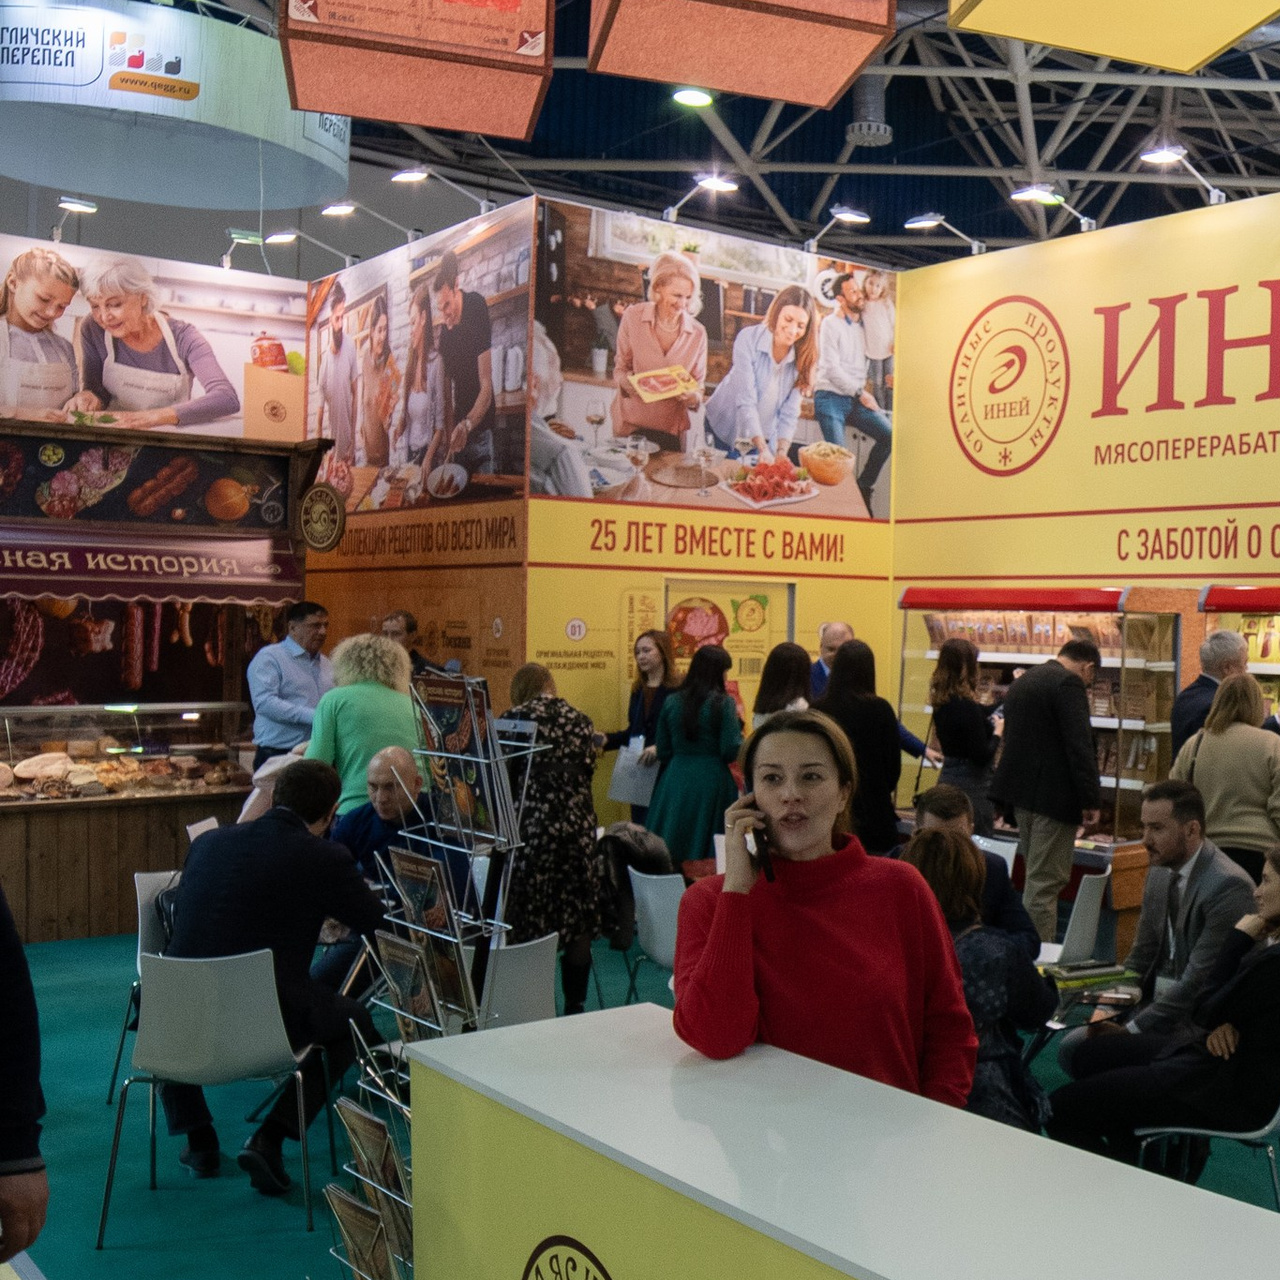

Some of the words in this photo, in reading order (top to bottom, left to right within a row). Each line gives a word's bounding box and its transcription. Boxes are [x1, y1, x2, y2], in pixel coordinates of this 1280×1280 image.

[1, 47, 76, 68] ПЕРЕПЕЛ
[119, 76, 191, 95] www.qegg.ru
[983, 396, 1031, 421] ИНЕЙ
[337, 526, 387, 561] ОЛЛЕКЦИЯ
[387, 522, 434, 560] РЕЦЕПТОВ
[436, 521, 449, 553] СО
[451, 519, 482, 553] ВСЕГО
[485, 516, 517, 550] МИРА
[590, 518, 617, 552] 25
[623, 522, 668, 554] ЛЕТ
[673, 524, 756, 558] ВМЕСТЕ
[762, 531, 775, 559] С
[782, 531, 845, 563] ВАМИ!
[1116, 529, 1130, 562] С
[1136, 518, 1239, 562] ЗАБОТОЙ
[1247, 528, 1263, 559] О
[0, 551, 72, 571] ная
[85, 552, 241, 577] история
